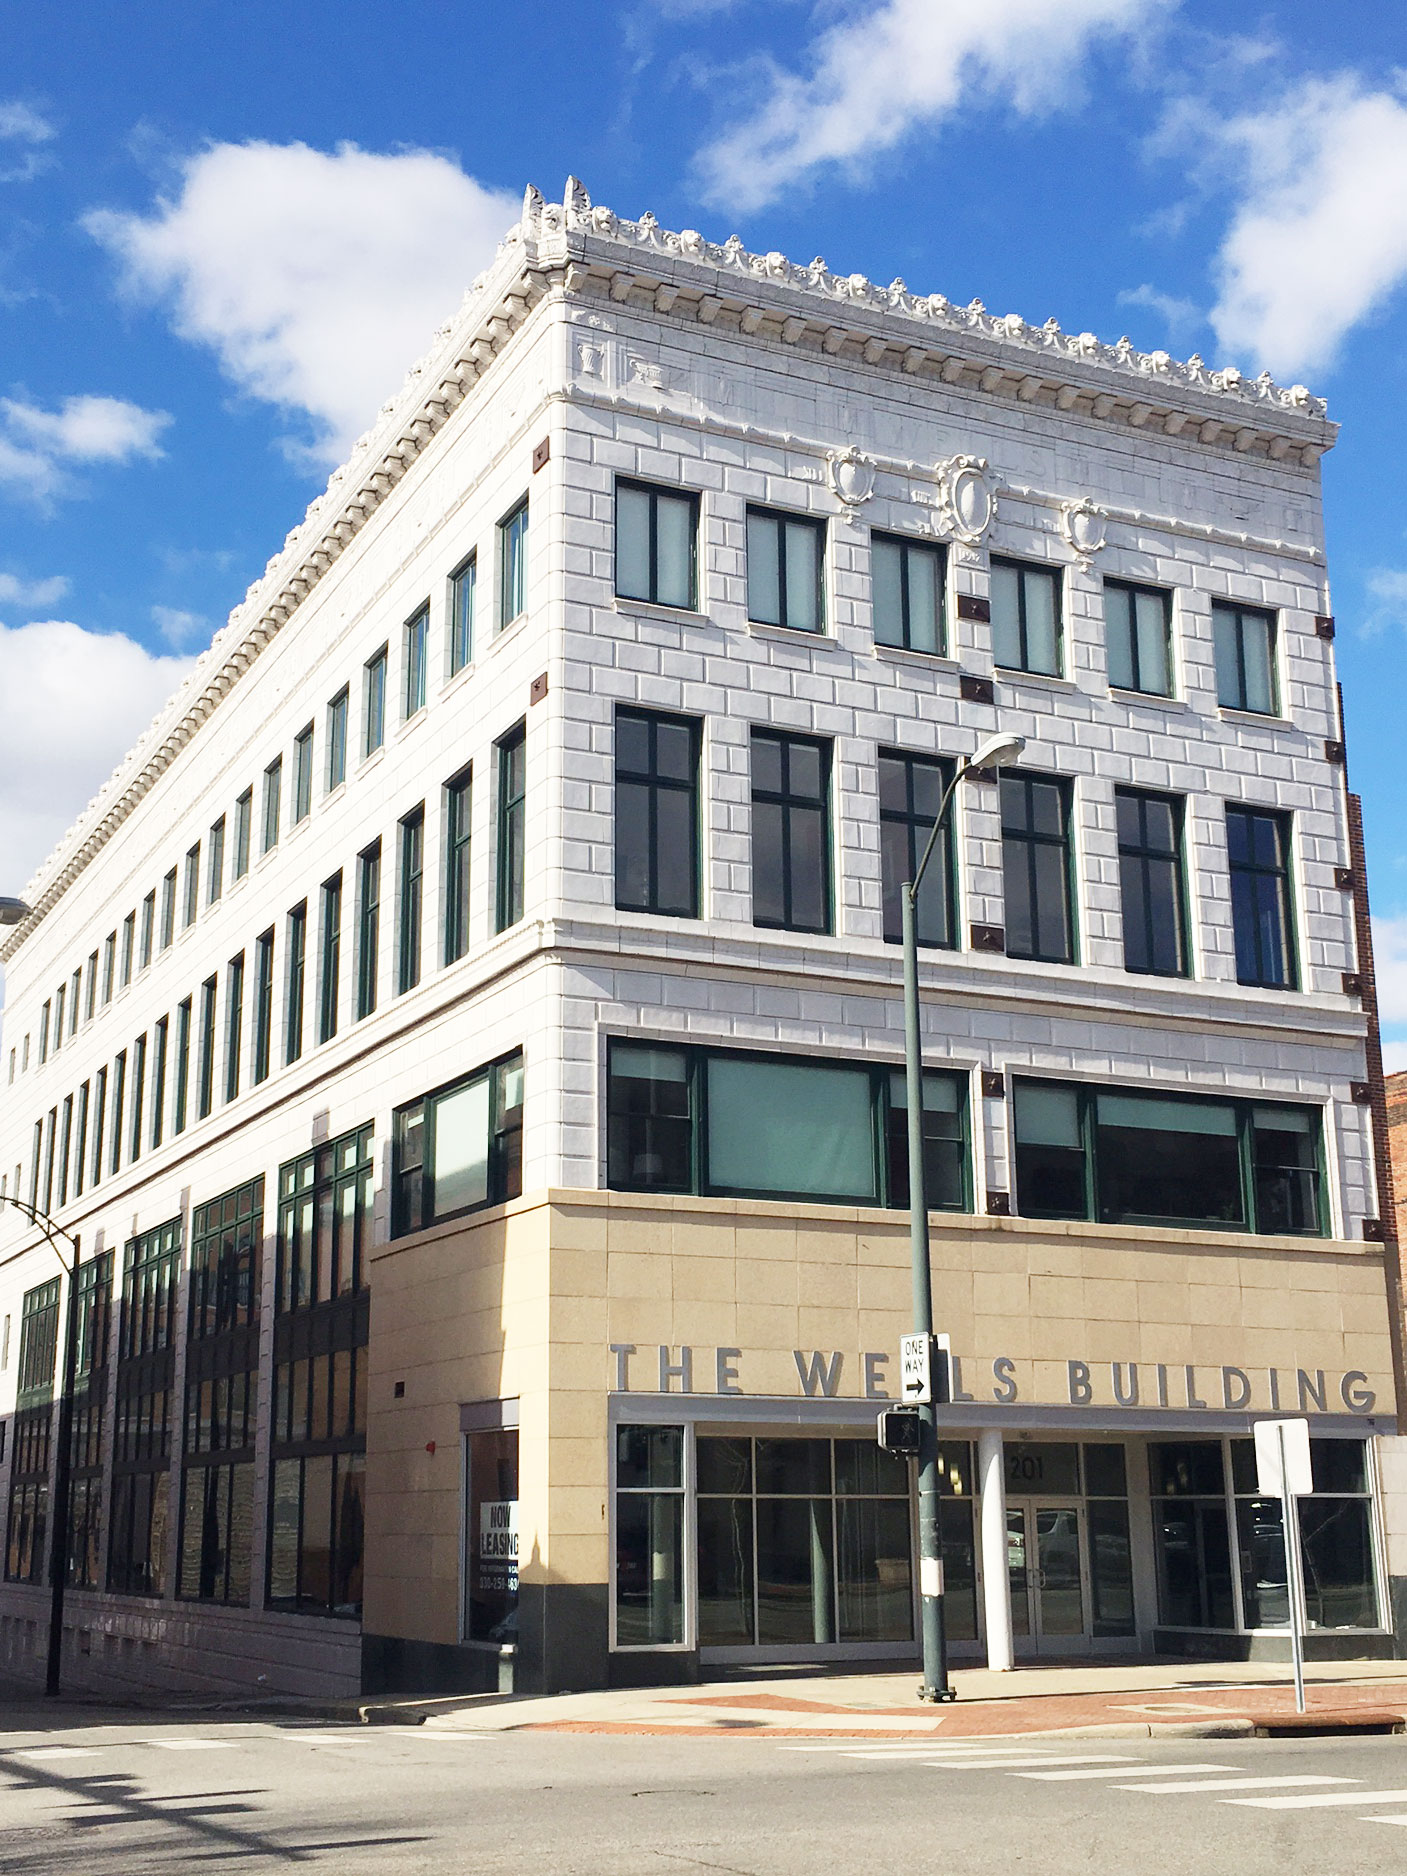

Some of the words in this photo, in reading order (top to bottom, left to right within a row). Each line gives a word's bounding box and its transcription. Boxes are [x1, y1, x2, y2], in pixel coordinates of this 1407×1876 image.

[905, 1340, 924, 1356] ONE
[905, 1359, 924, 1374] WAY
[609, 1343, 744, 1394] THE
[793, 1350, 1018, 1403] WELS
[1066, 1359, 1378, 1414] BUILDING
[1010, 1455, 1043, 1480] 201
[490, 1505, 511, 1528] NOW
